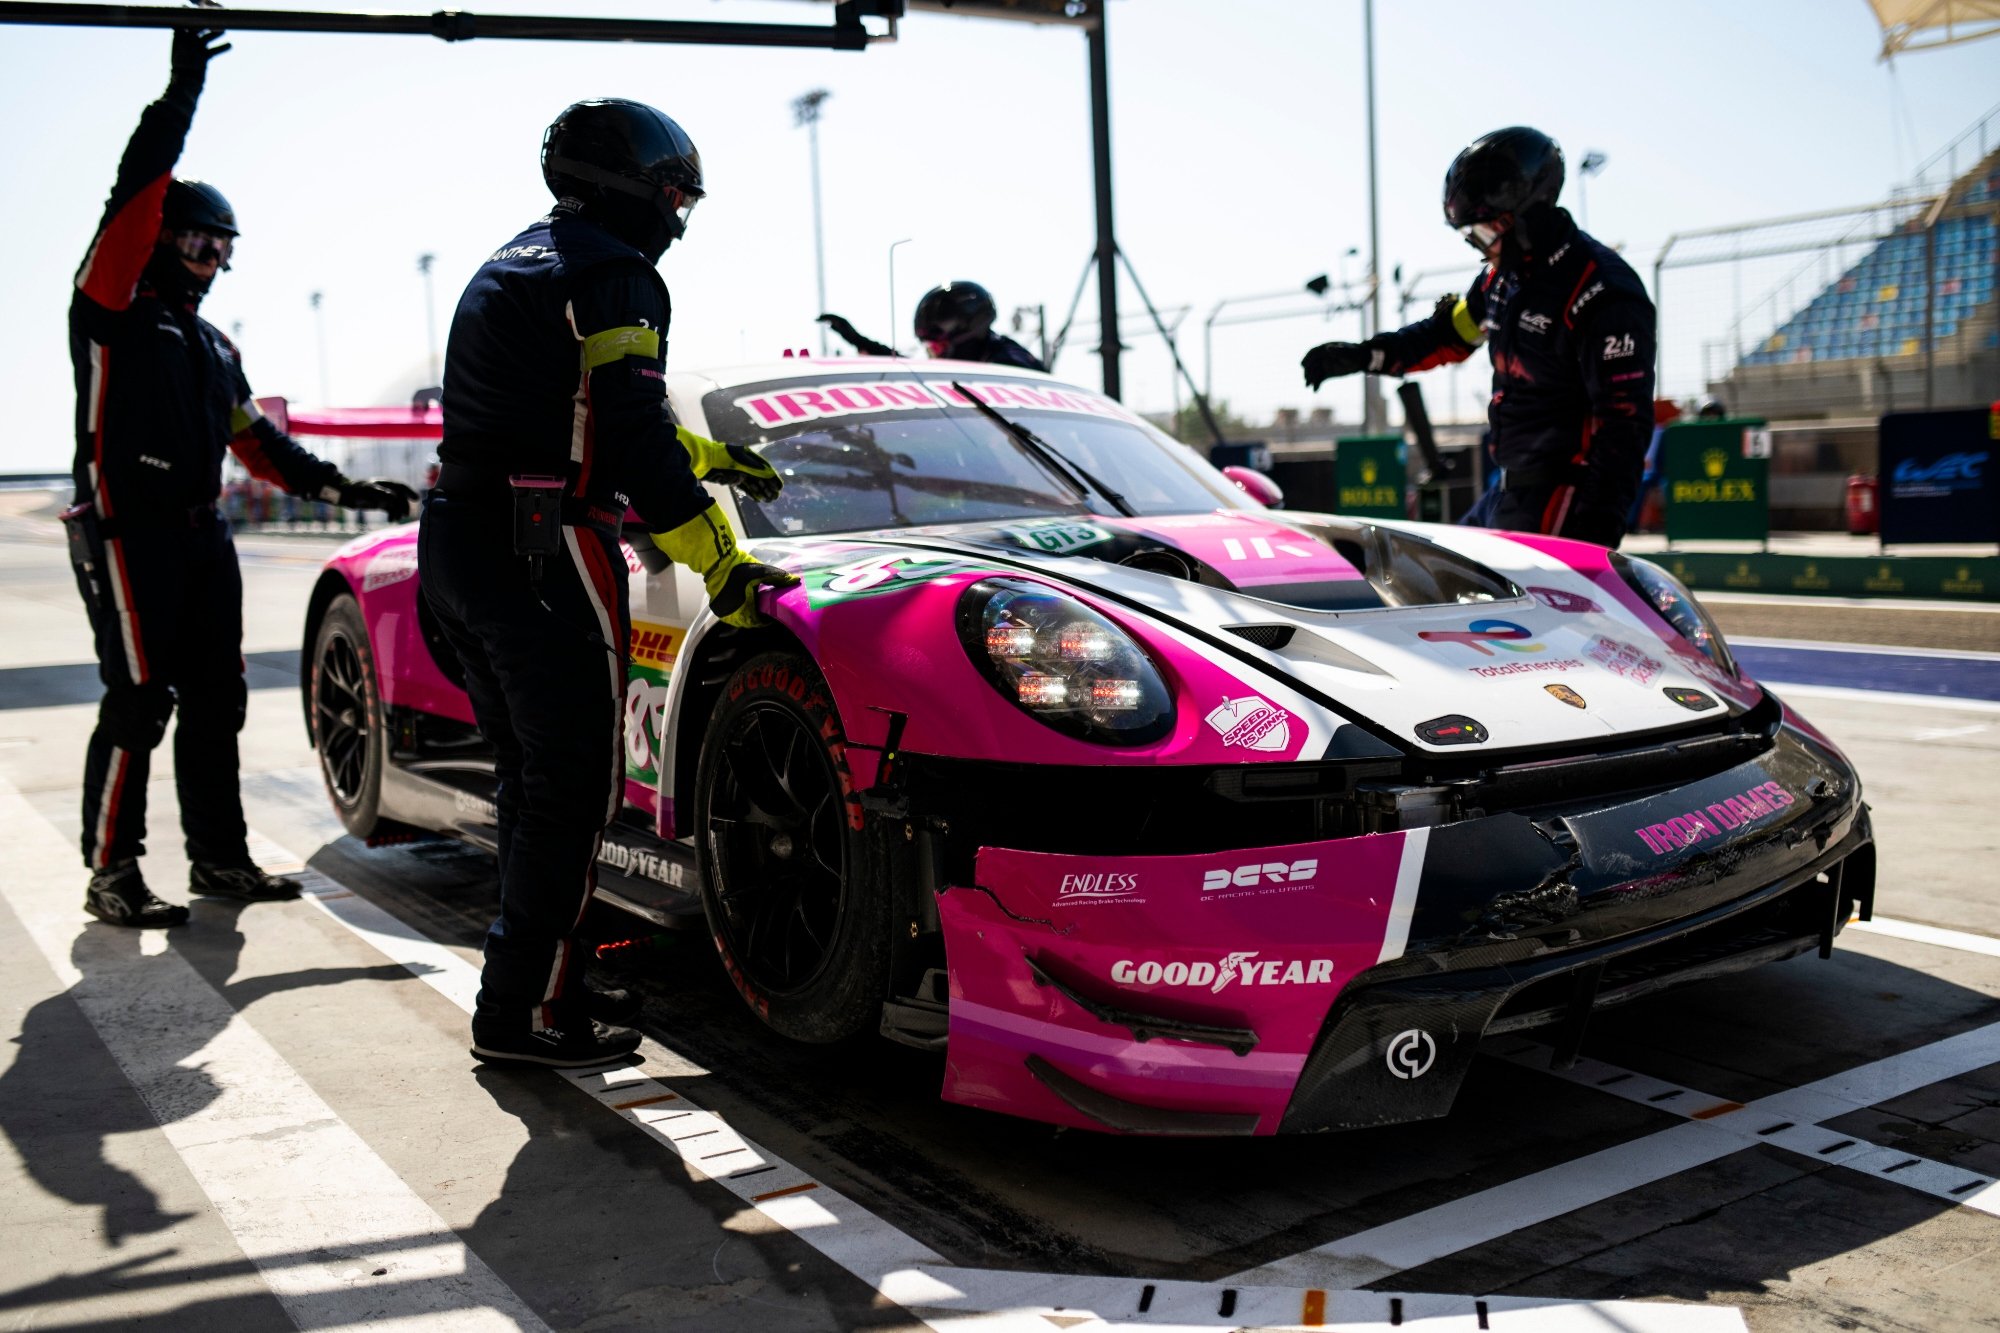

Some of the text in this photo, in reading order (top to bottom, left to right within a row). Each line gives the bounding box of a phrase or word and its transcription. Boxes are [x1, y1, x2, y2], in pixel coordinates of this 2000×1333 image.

[743, 383, 937, 424] IRON
[1674, 480, 1756, 503] ROLEX
[1469, 657, 1585, 678] TotalEnergies
[1223, 708, 1269, 745] SPEED
[1242, 710, 1288, 747] IS PINK
[1634, 781, 1796, 856] IRON DAMES
[1059, 873, 1139, 894] ENDLESS
[1218, 890, 1255, 900] RACING
[1259, 884, 1315, 895] SOLUTIONS
[1052, 900, 1078, 908] Advanced
